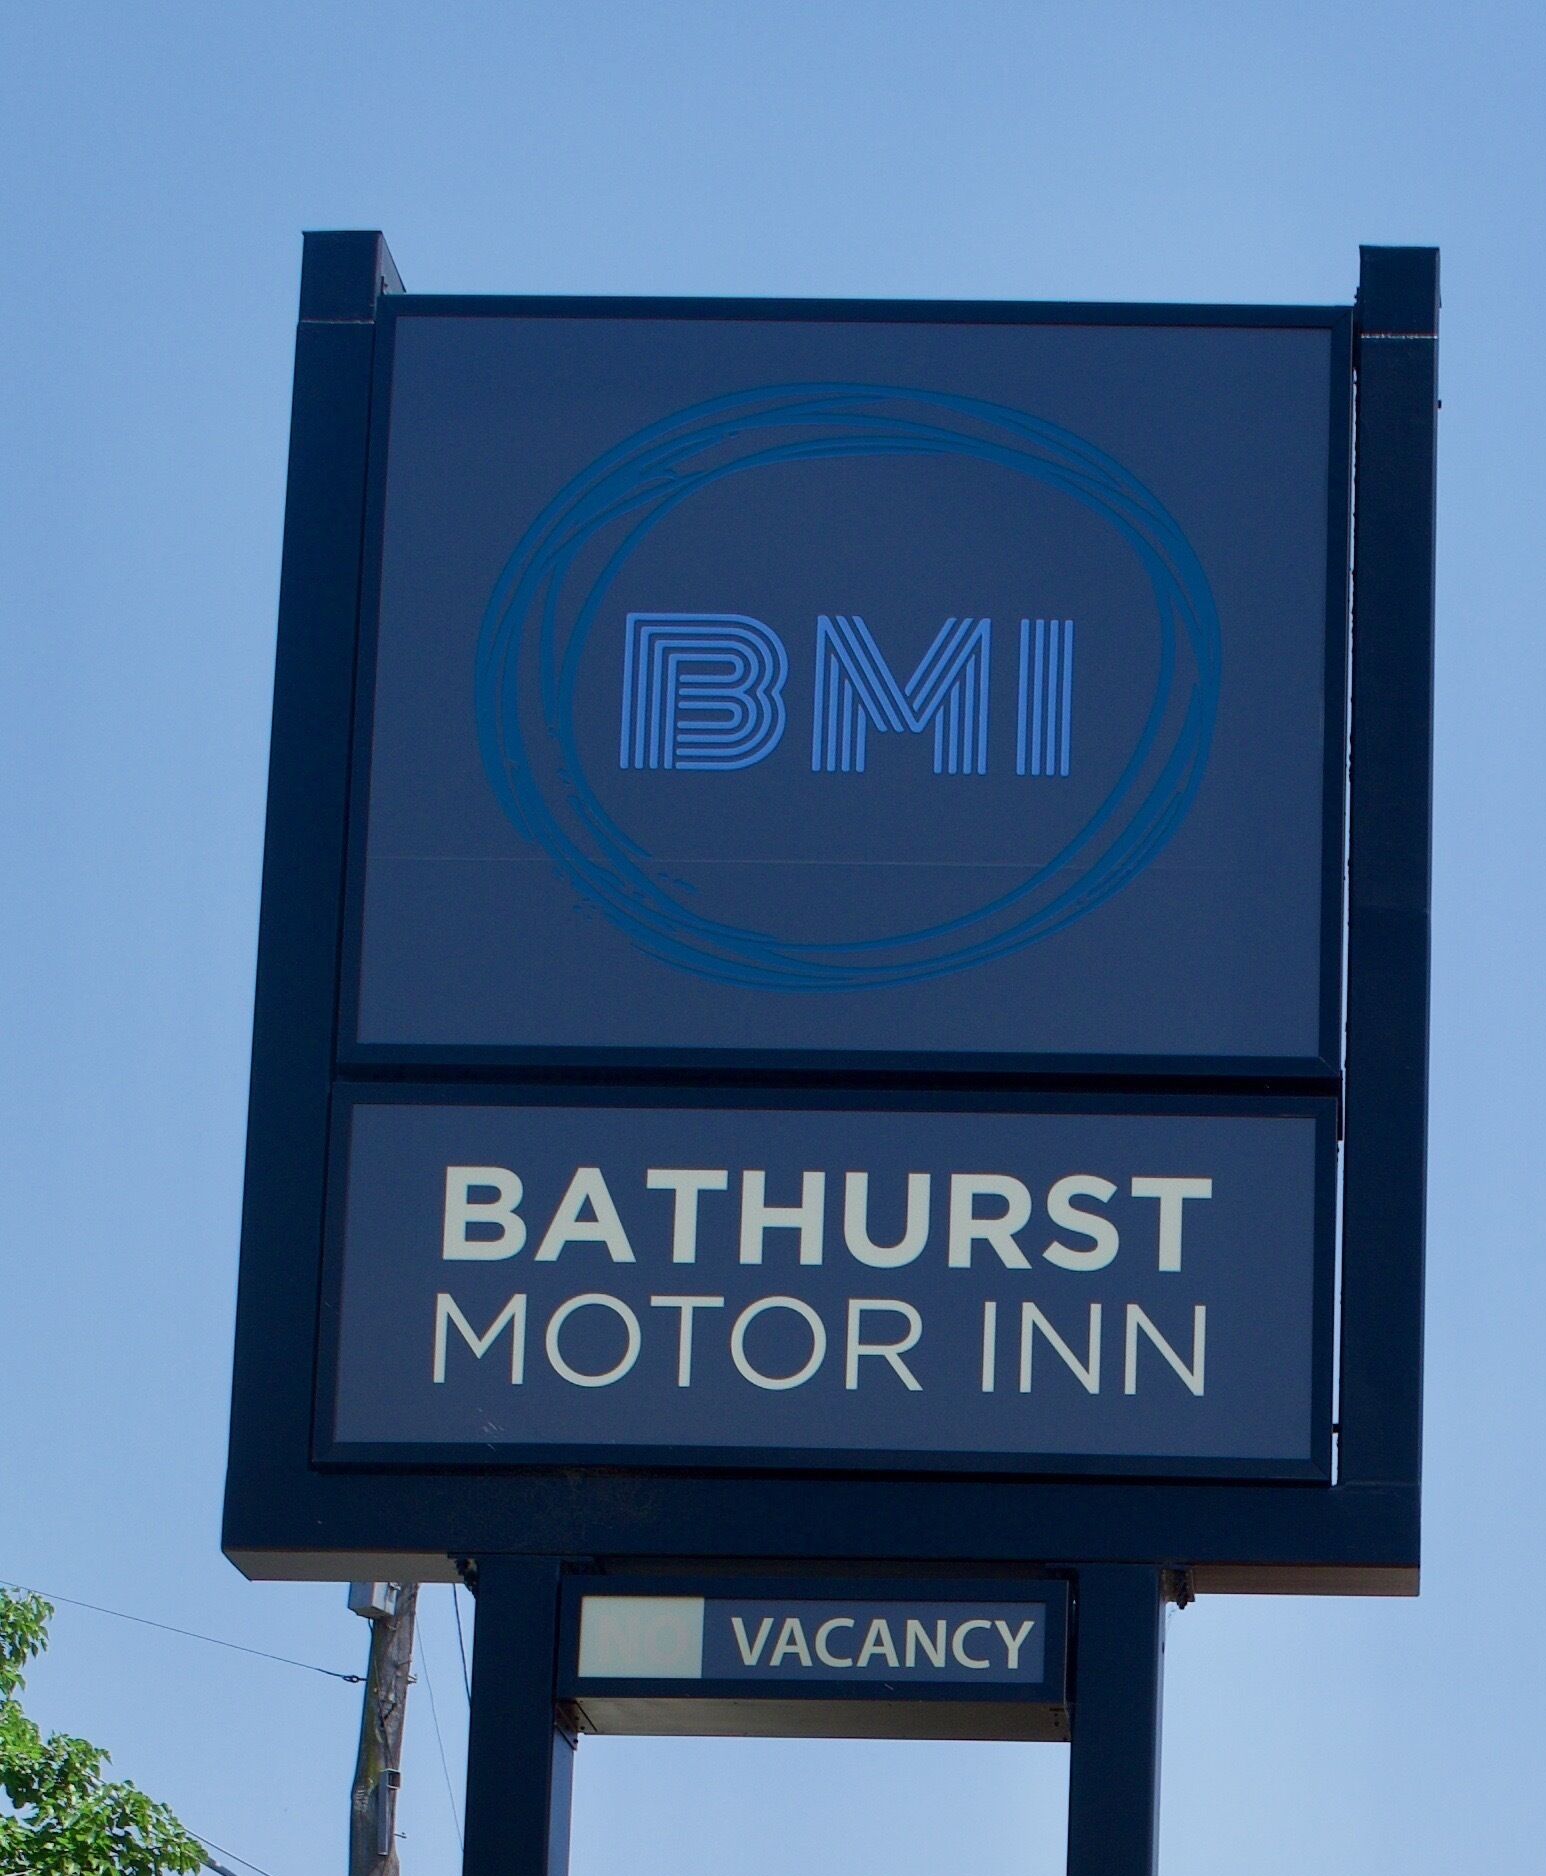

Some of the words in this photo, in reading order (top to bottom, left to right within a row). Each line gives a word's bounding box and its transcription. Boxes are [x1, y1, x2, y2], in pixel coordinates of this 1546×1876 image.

[617, 611, 1075, 777] BMI
[442, 1166, 1214, 1273] BATHURST
[431, 1292, 924, 1391] MOTOR
[981, 1301, 1208, 1397] INN
[731, 1617, 1035, 1670] VACANCY
